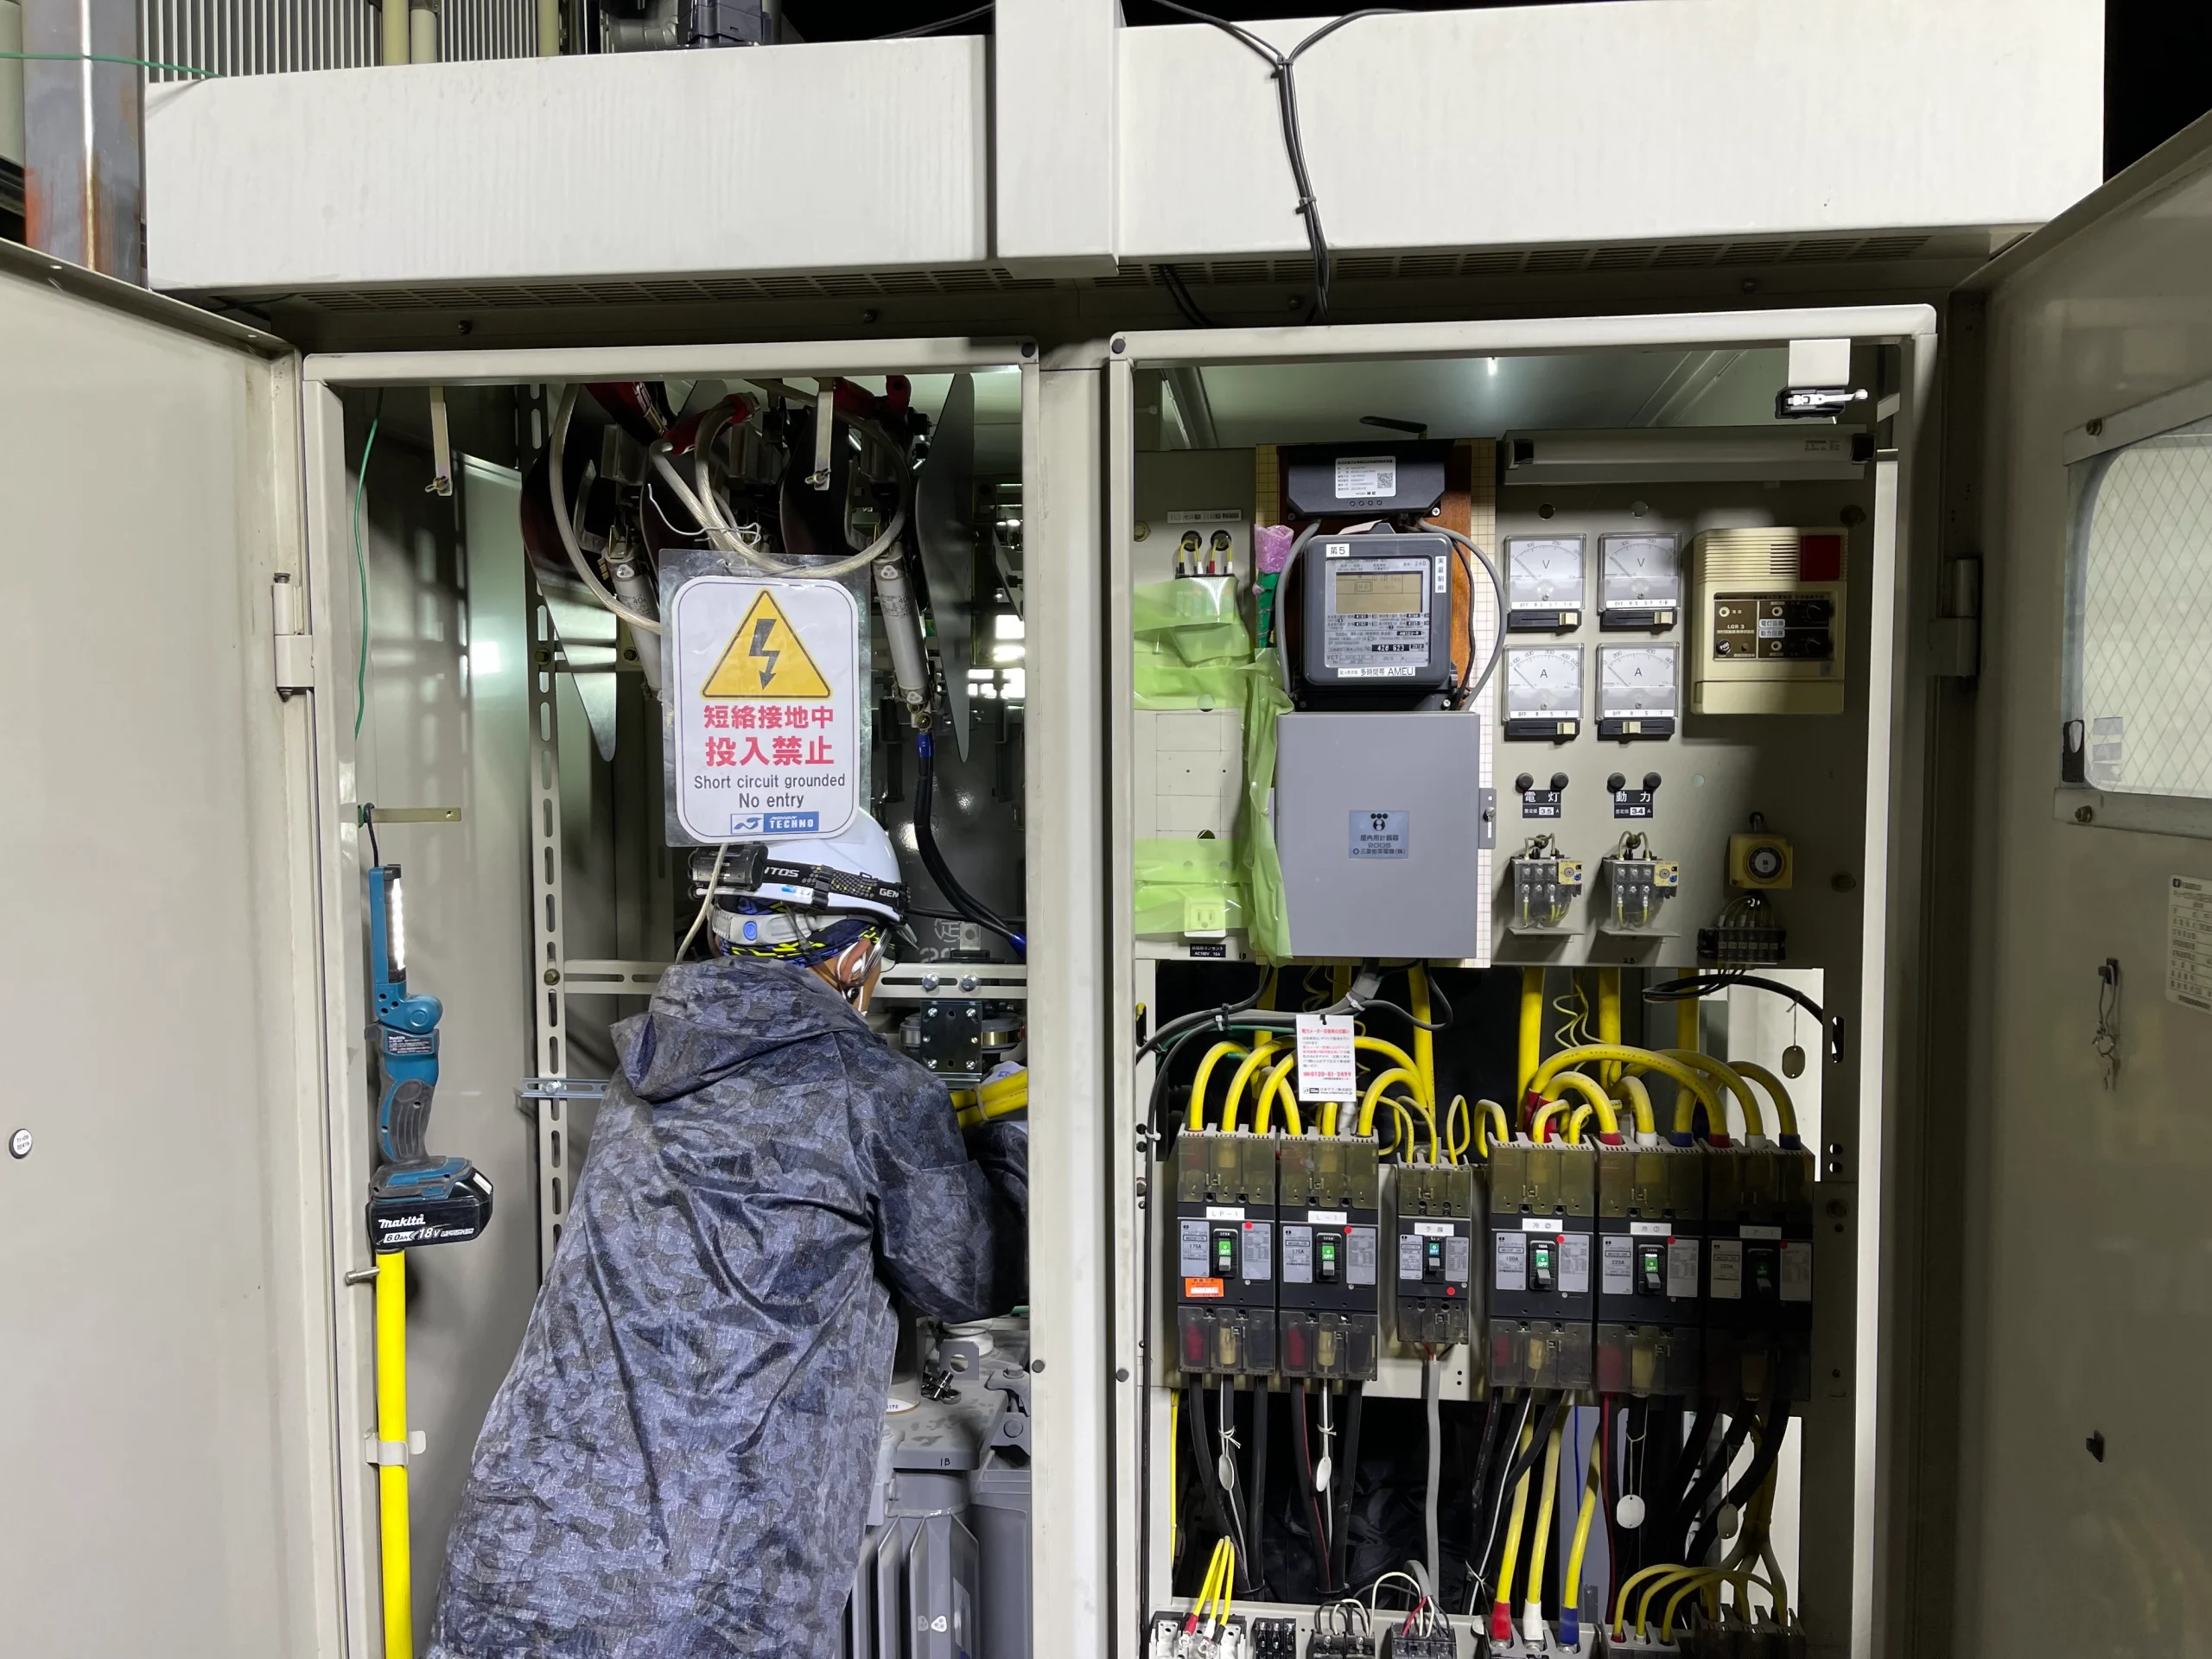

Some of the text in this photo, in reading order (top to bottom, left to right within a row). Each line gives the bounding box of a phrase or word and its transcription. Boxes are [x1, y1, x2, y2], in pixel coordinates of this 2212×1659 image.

[1542, 559, 1550, 569] V
[1637, 557, 1645, 567] V
[1388, 667, 1414, 676] AMEU
[1540, 669, 1548, 678] A
[1634, 667, 1643, 677] A
[703, 705, 834, 729] 短絡接地中
[705, 735, 835, 767] 投入禁止
[694, 773, 845, 790] Short circuit grounded
[739, 793, 804, 810] No entry
[769, 819, 814, 829] TECHNO
[386, 1233, 409, 1242] 6.0Ah
[418, 1228, 441, 1239] 18V
